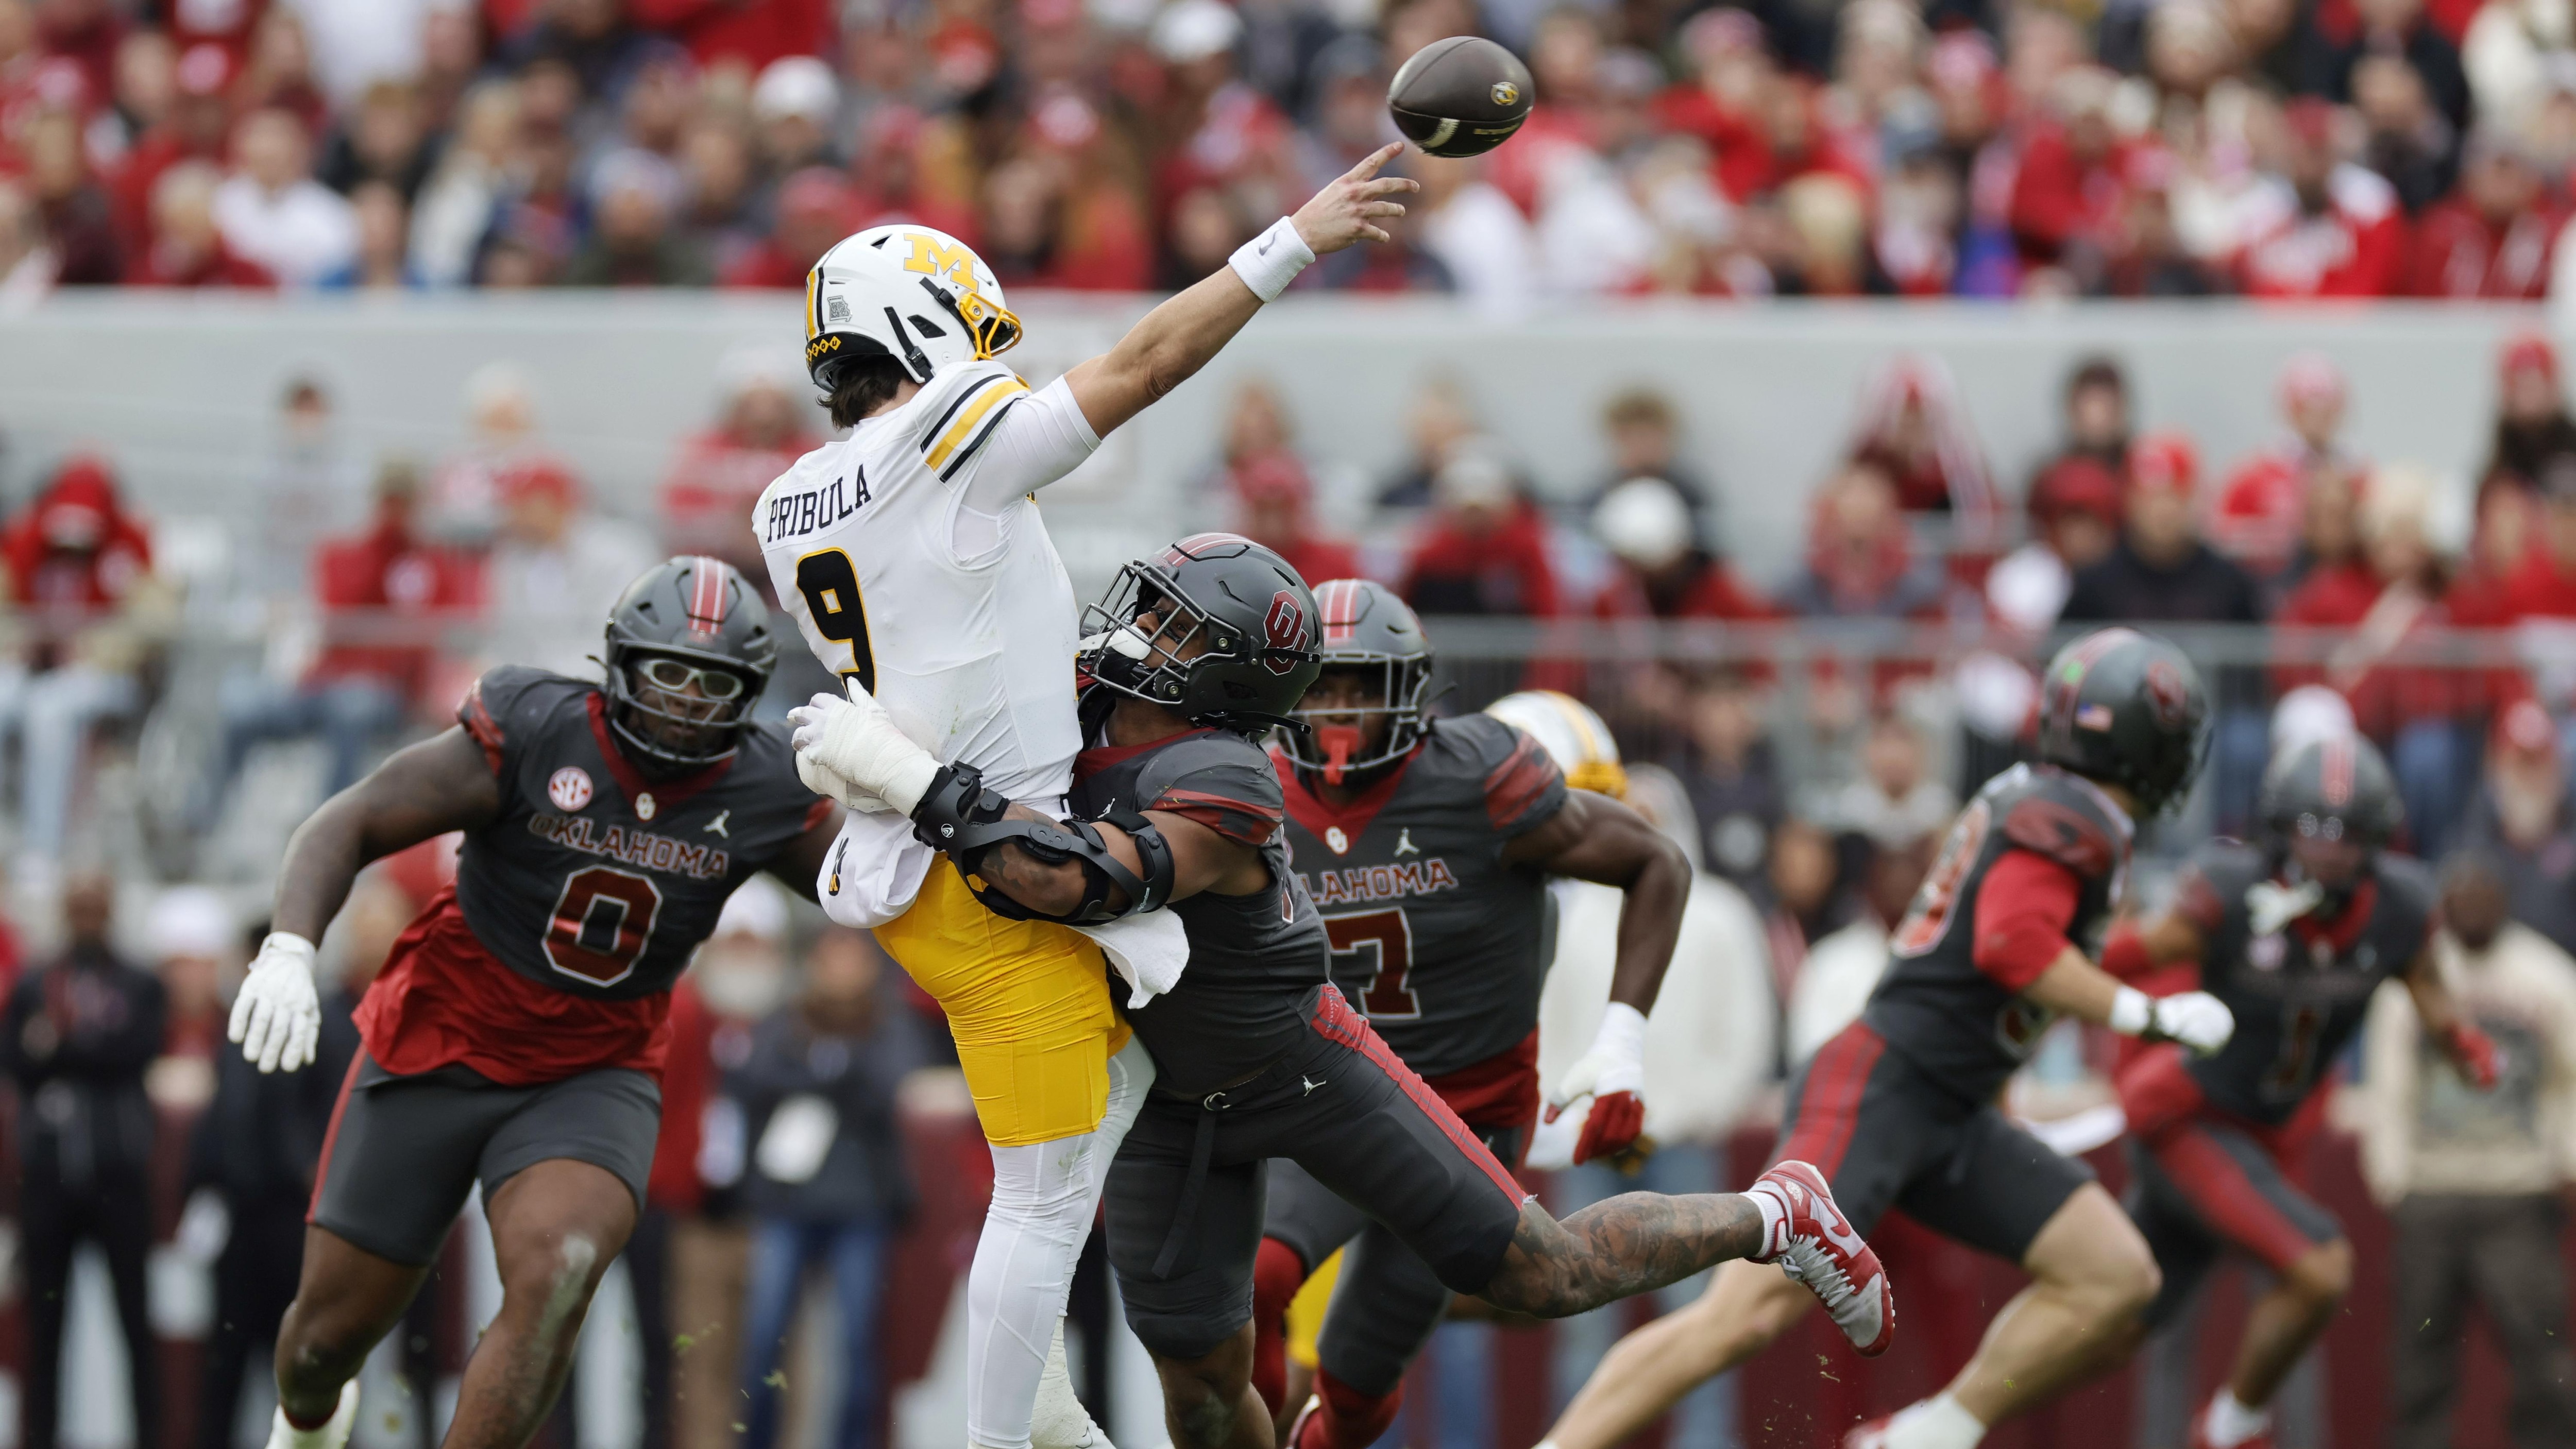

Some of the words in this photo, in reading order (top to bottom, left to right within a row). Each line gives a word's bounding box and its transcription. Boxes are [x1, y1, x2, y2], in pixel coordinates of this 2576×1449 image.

[904, 233, 979, 294] M
[767, 463, 872, 543] PRIBULA
[795, 546, 877, 707] 9
[550, 768, 592, 810] SEC
[528, 813, 729, 878] OKLAHOMA
[1298, 858, 1459, 906] LAHOMA
[541, 864, 663, 987] 0
[1320, 905, 1421, 1020] 7
